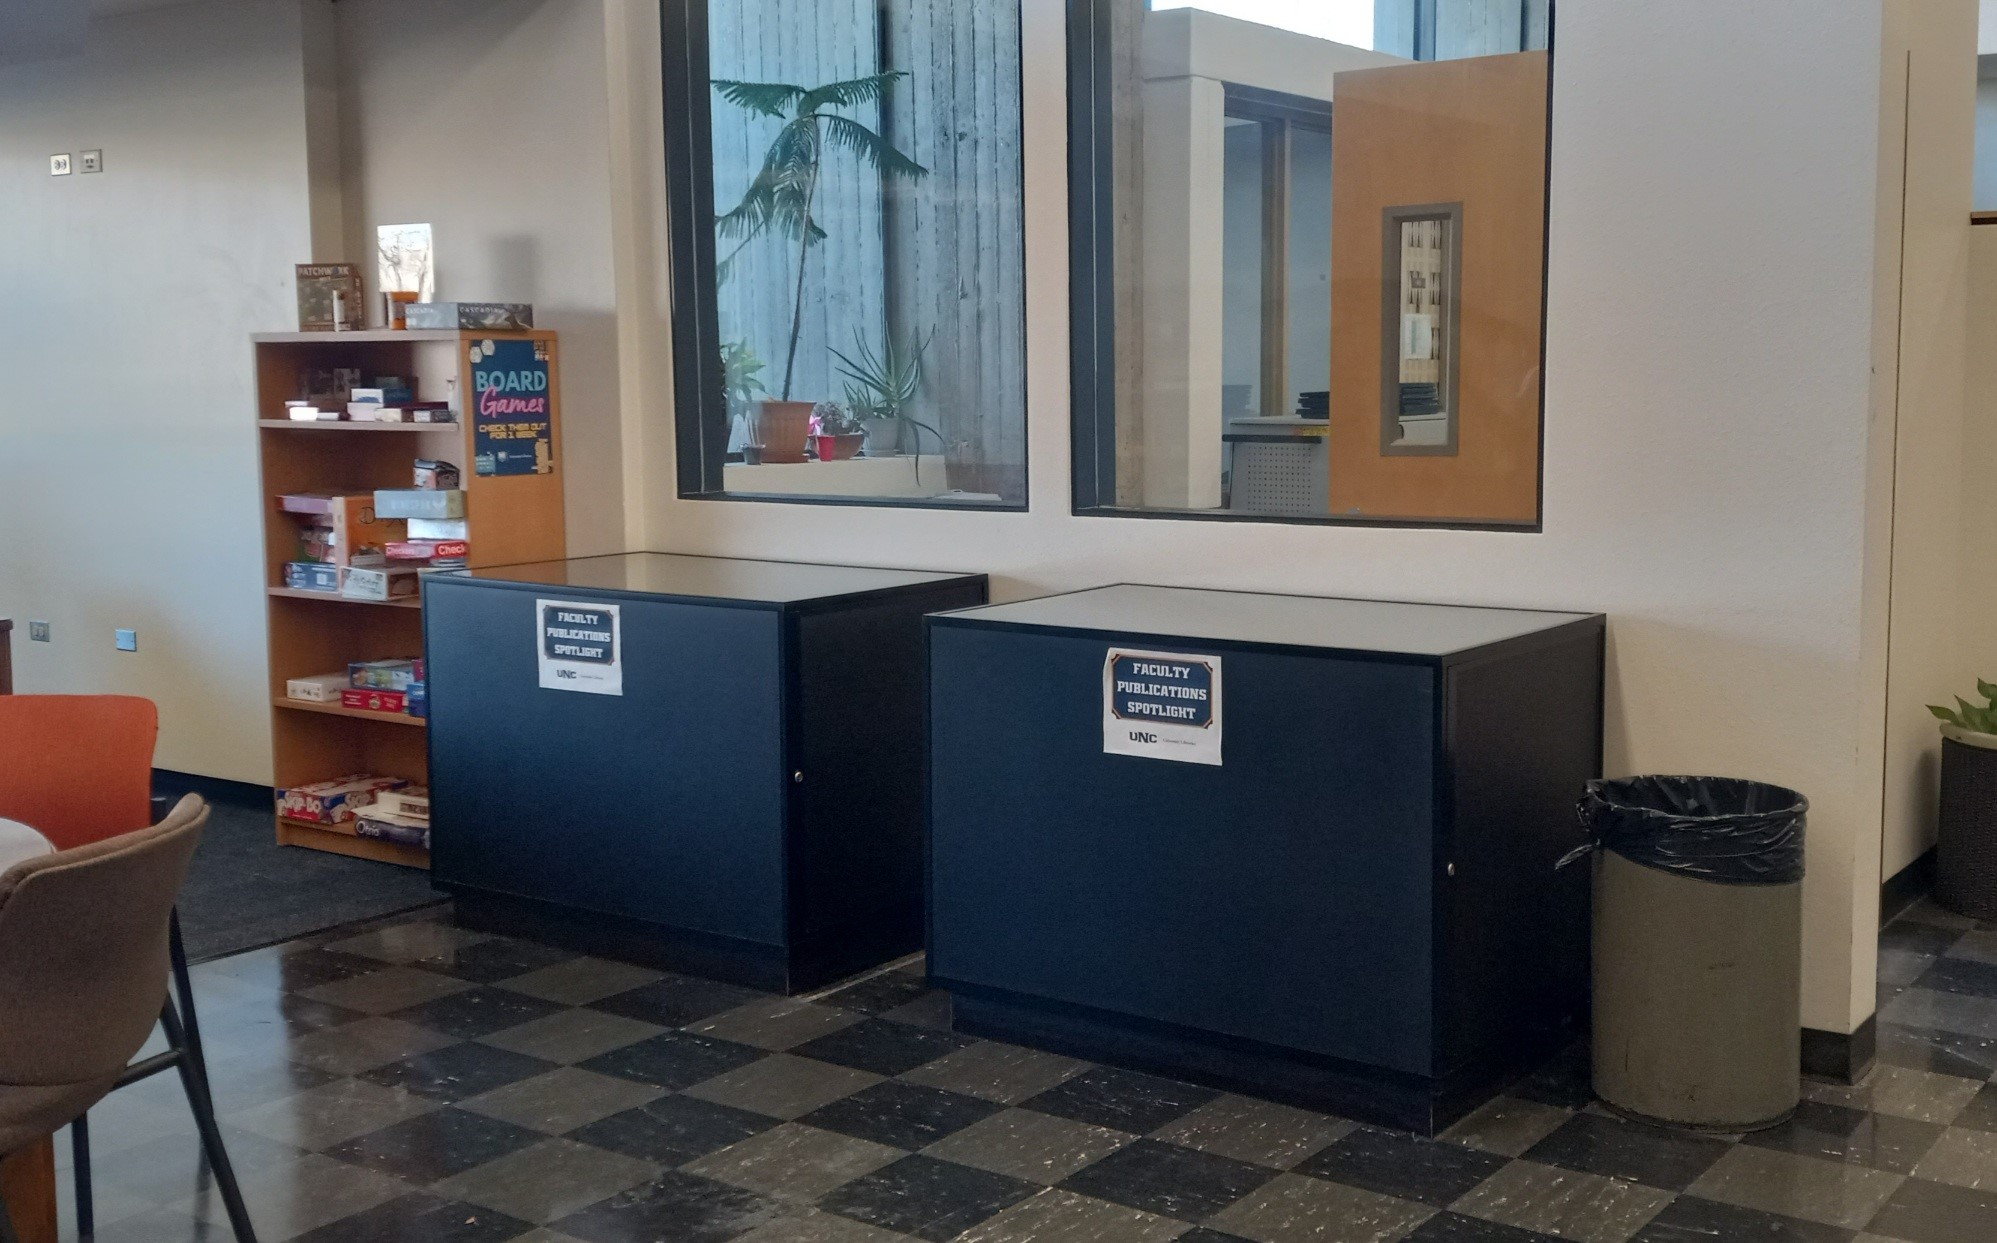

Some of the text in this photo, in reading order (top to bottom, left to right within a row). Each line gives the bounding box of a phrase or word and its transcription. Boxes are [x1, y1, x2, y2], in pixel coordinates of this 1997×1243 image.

[475, 370, 546, 392] BOARD
[480, 386, 545, 418] Games
[479, 424, 506, 432] CHECK
[530, 422, 547, 430] OUT
[489, 431, 507, 439] FOR
[558, 612, 598, 625] FACULTY
[546, 627, 611, 642] PUBLICATIONS
[554, 644, 603, 658] SPOTLIGHT
[556, 669, 577, 679] UNC
[1133, 662, 1190, 679] FACULTY
[1117, 680, 1207, 701] PUBLICATIONS
[1128, 701, 1196, 720] SPOTLIGHT
[1130, 731, 1157, 744] UNC
